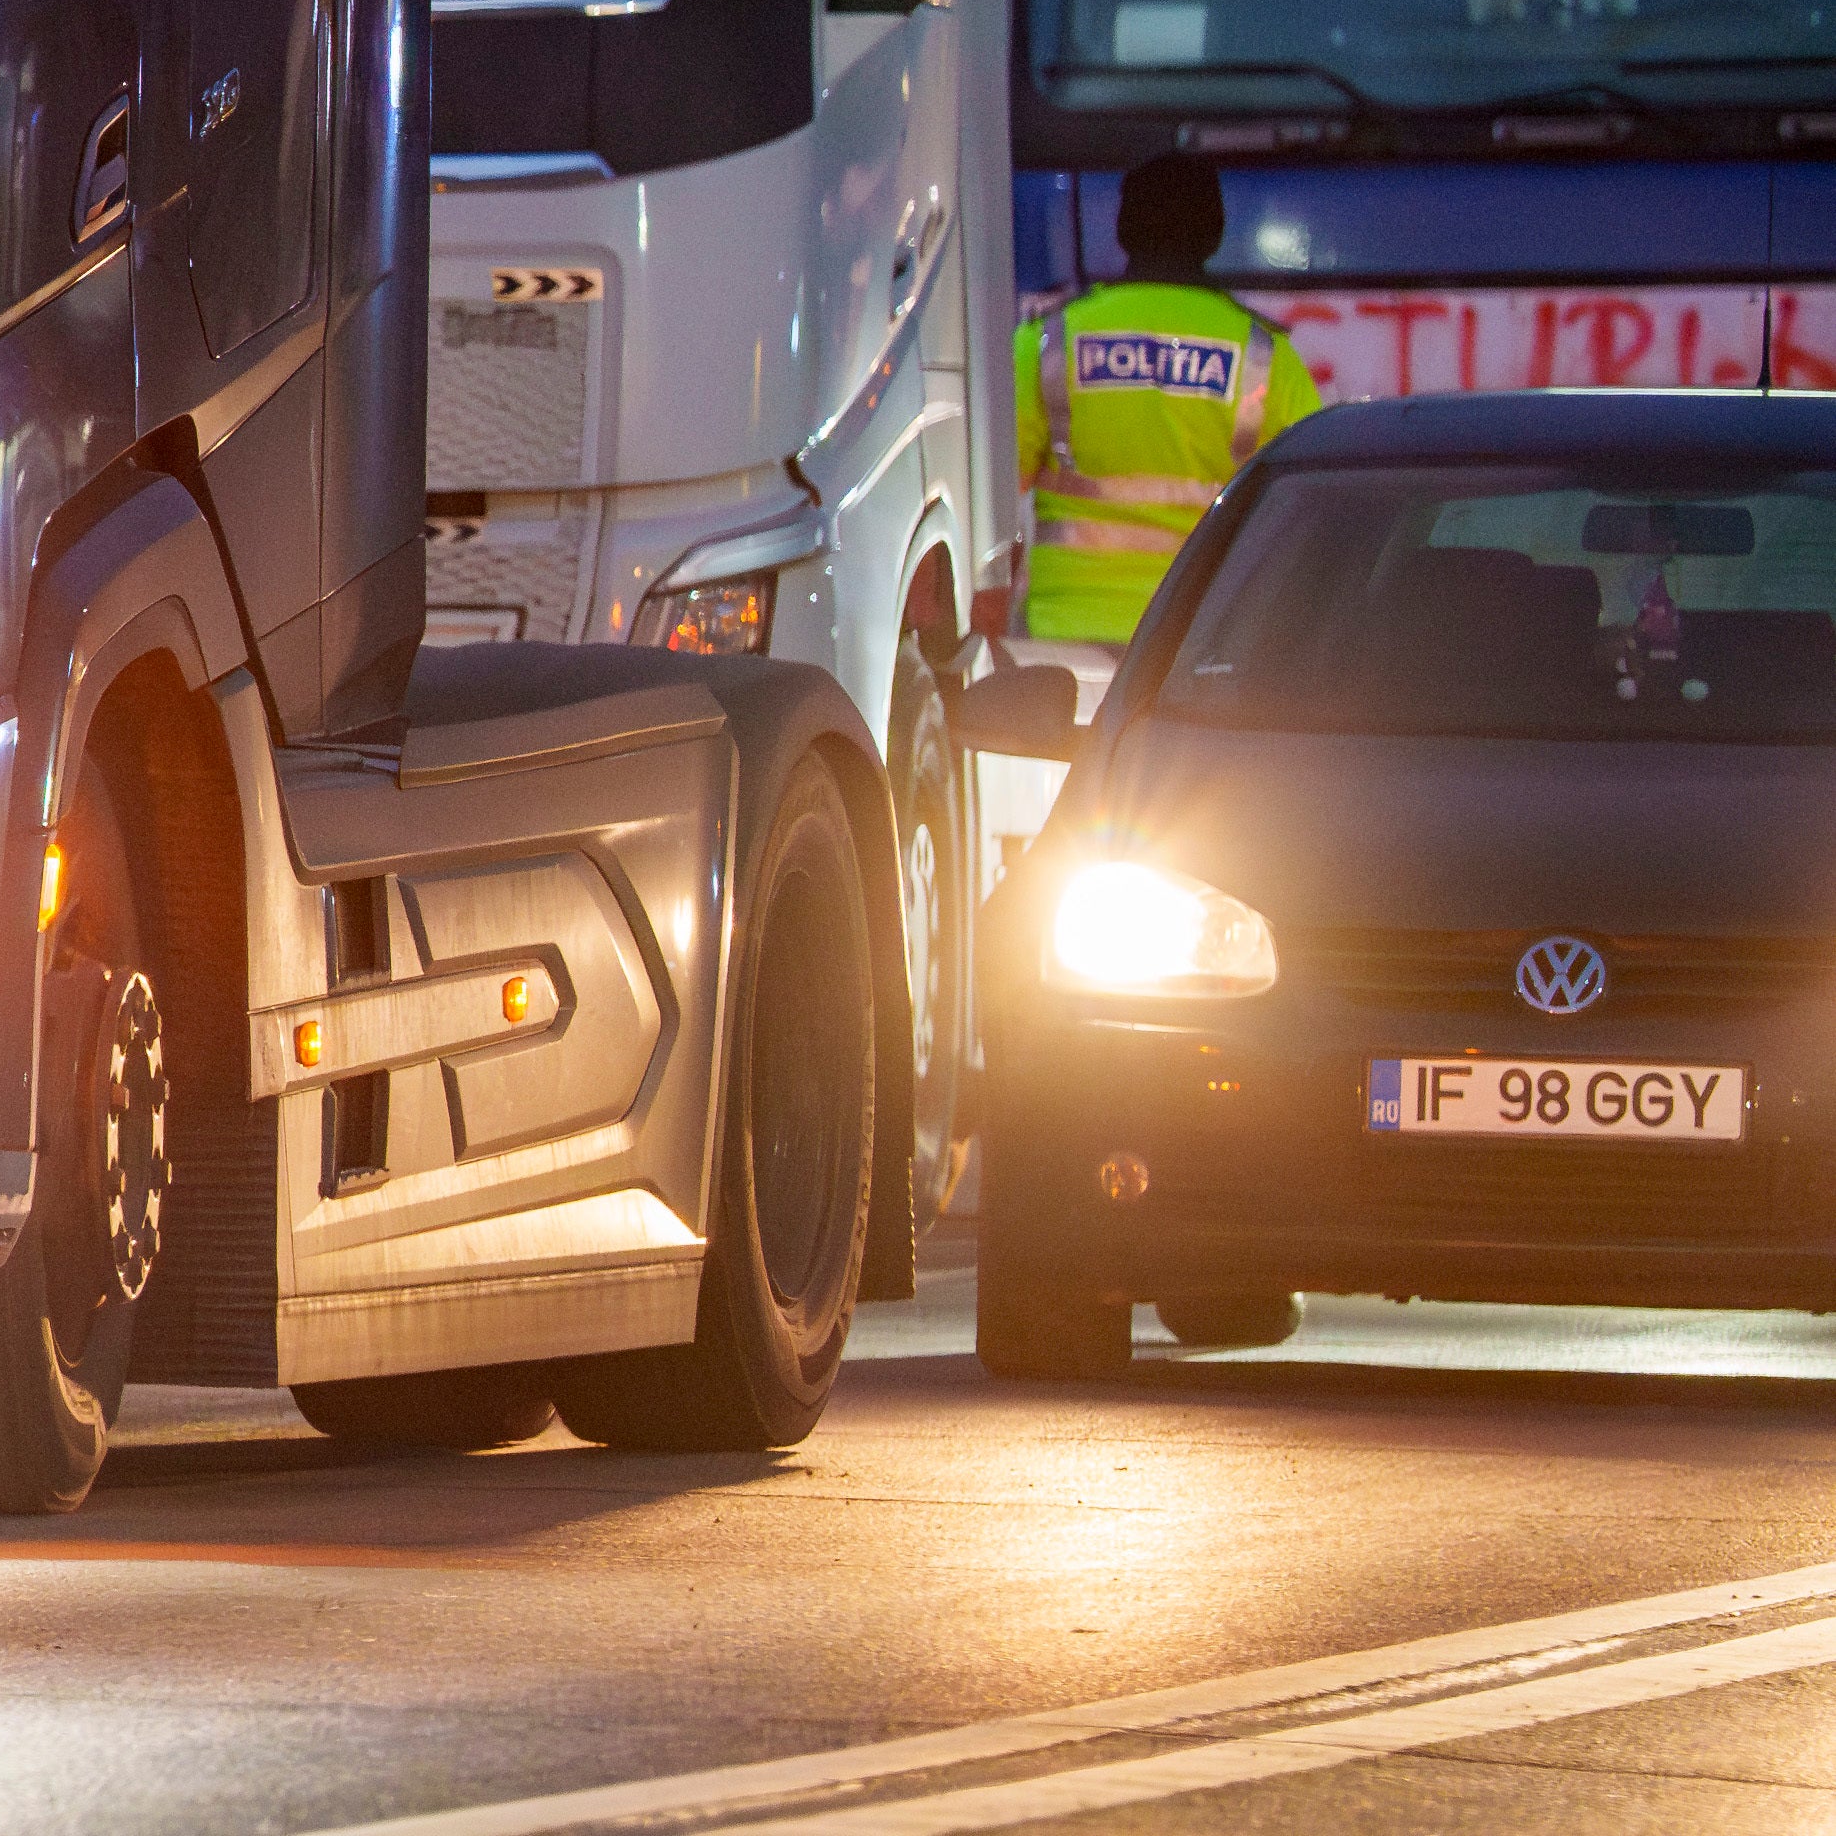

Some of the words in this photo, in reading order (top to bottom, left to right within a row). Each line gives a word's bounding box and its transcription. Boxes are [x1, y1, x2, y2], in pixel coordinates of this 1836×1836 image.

[1371, 1098, 1400, 1124] RO
[1416, 1066, 1473, 1123] IF
[1498, 1068, 1571, 1126] 98
[1585, 1071, 1721, 1130] GGY
